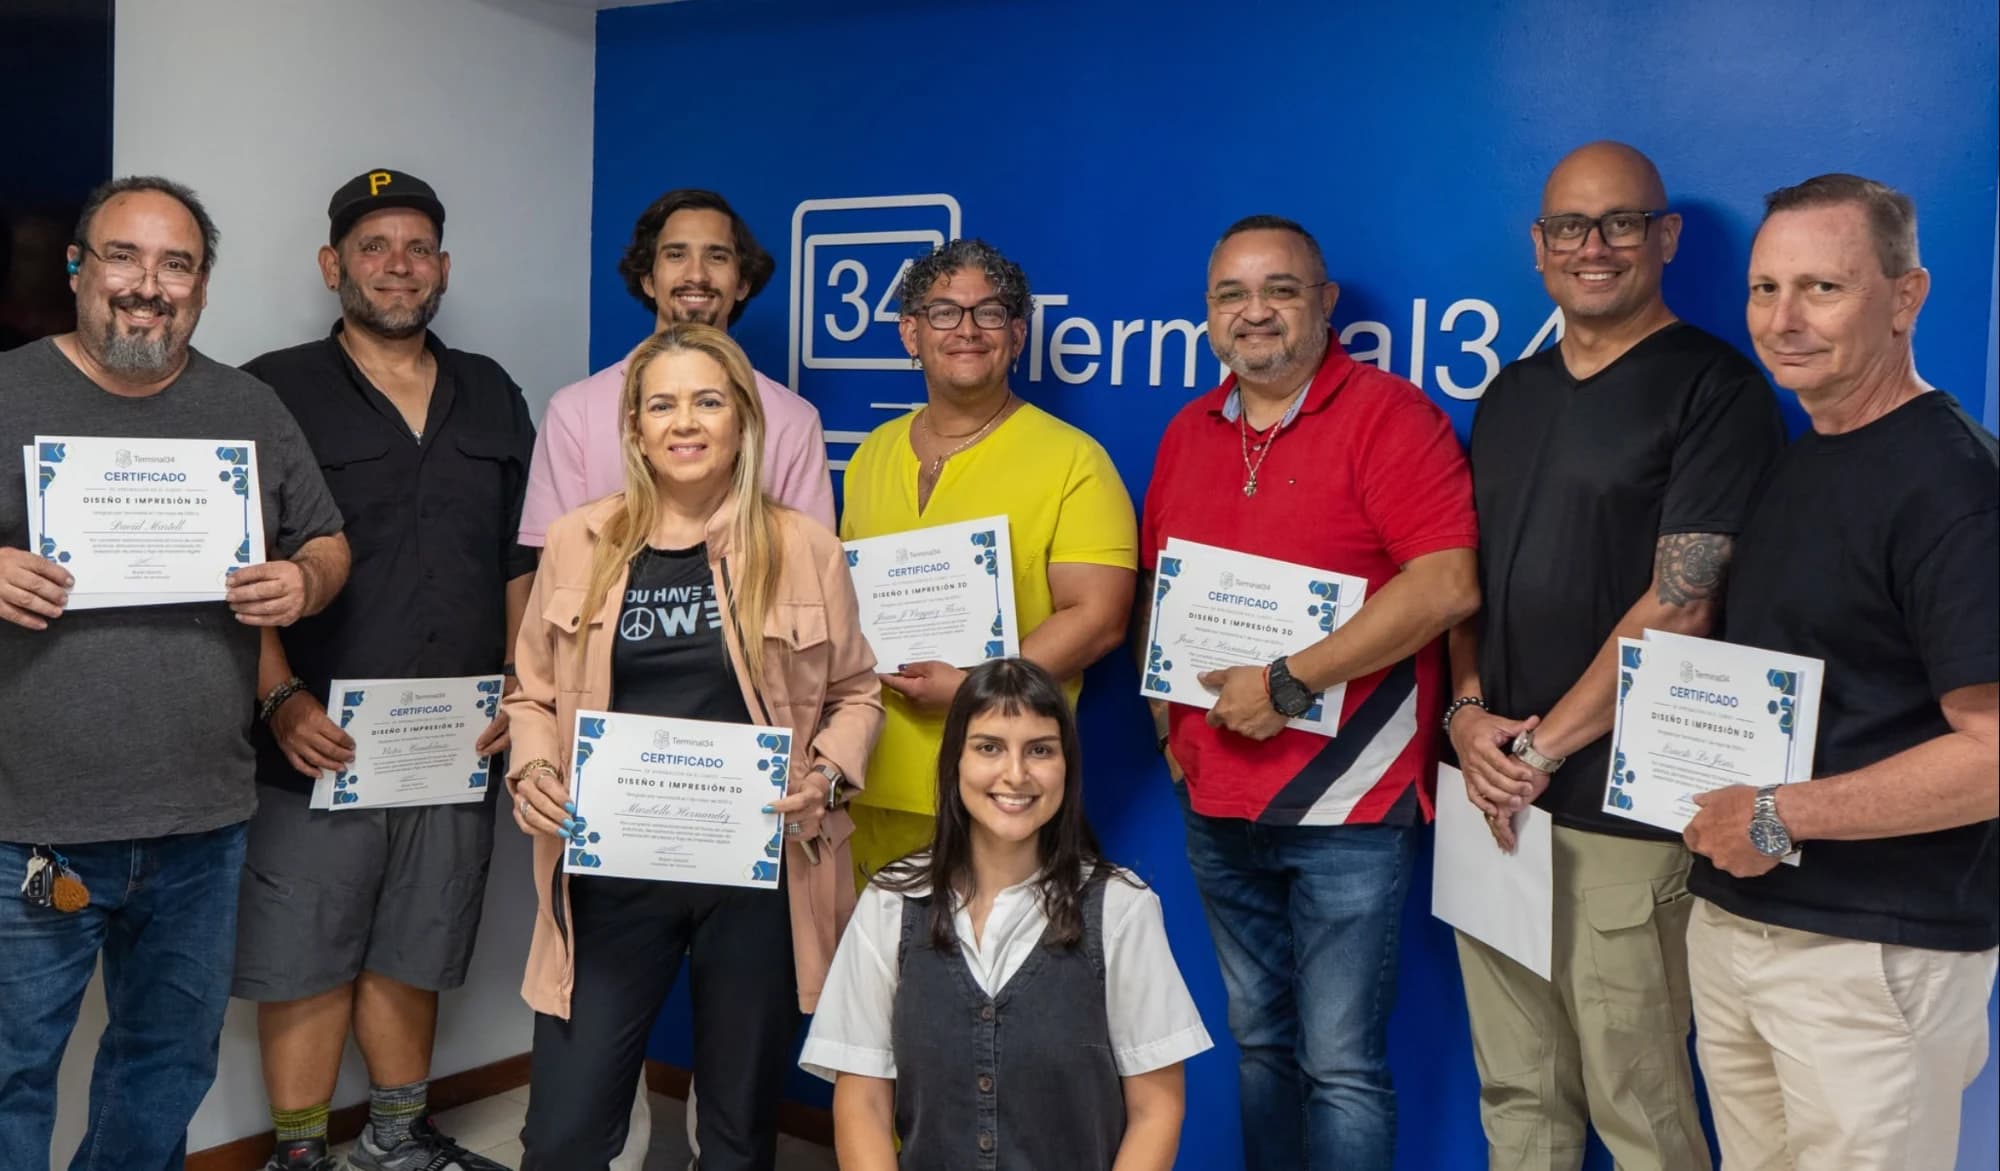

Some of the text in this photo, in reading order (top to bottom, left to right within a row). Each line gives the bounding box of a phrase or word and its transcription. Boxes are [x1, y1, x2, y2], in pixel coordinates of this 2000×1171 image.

[369, 172, 392, 196] P
[1029, 294, 1565, 400] Termal3
[104, 471, 187, 482] CERTIFICADO
[135, 497, 191, 505] IMPRESIÓN
[888, 562, 951, 578] CERTIFICADO
[625, 589, 650, 604] OU
[653, 586, 702, 603] HAVE
[911, 583, 955, 595] IMPRESIÓN
[1208, 591, 1278, 611] CERTIFICADO
[1229, 619, 1279, 634] IMPRESIÓN
[1670, 685, 1739, 708] CERTIFICADO
[390, 704, 453, 717] CERTIFICADO
[410, 723, 453, 732] IMPRESIÓN
[1692, 721, 1740, 736] IMPRESIÓN
[672, 736, 715, 748] Terminal34
[640, 751, 724, 769] CERTIFICADO
[669, 781, 726, 792] IMPRESIÓN
